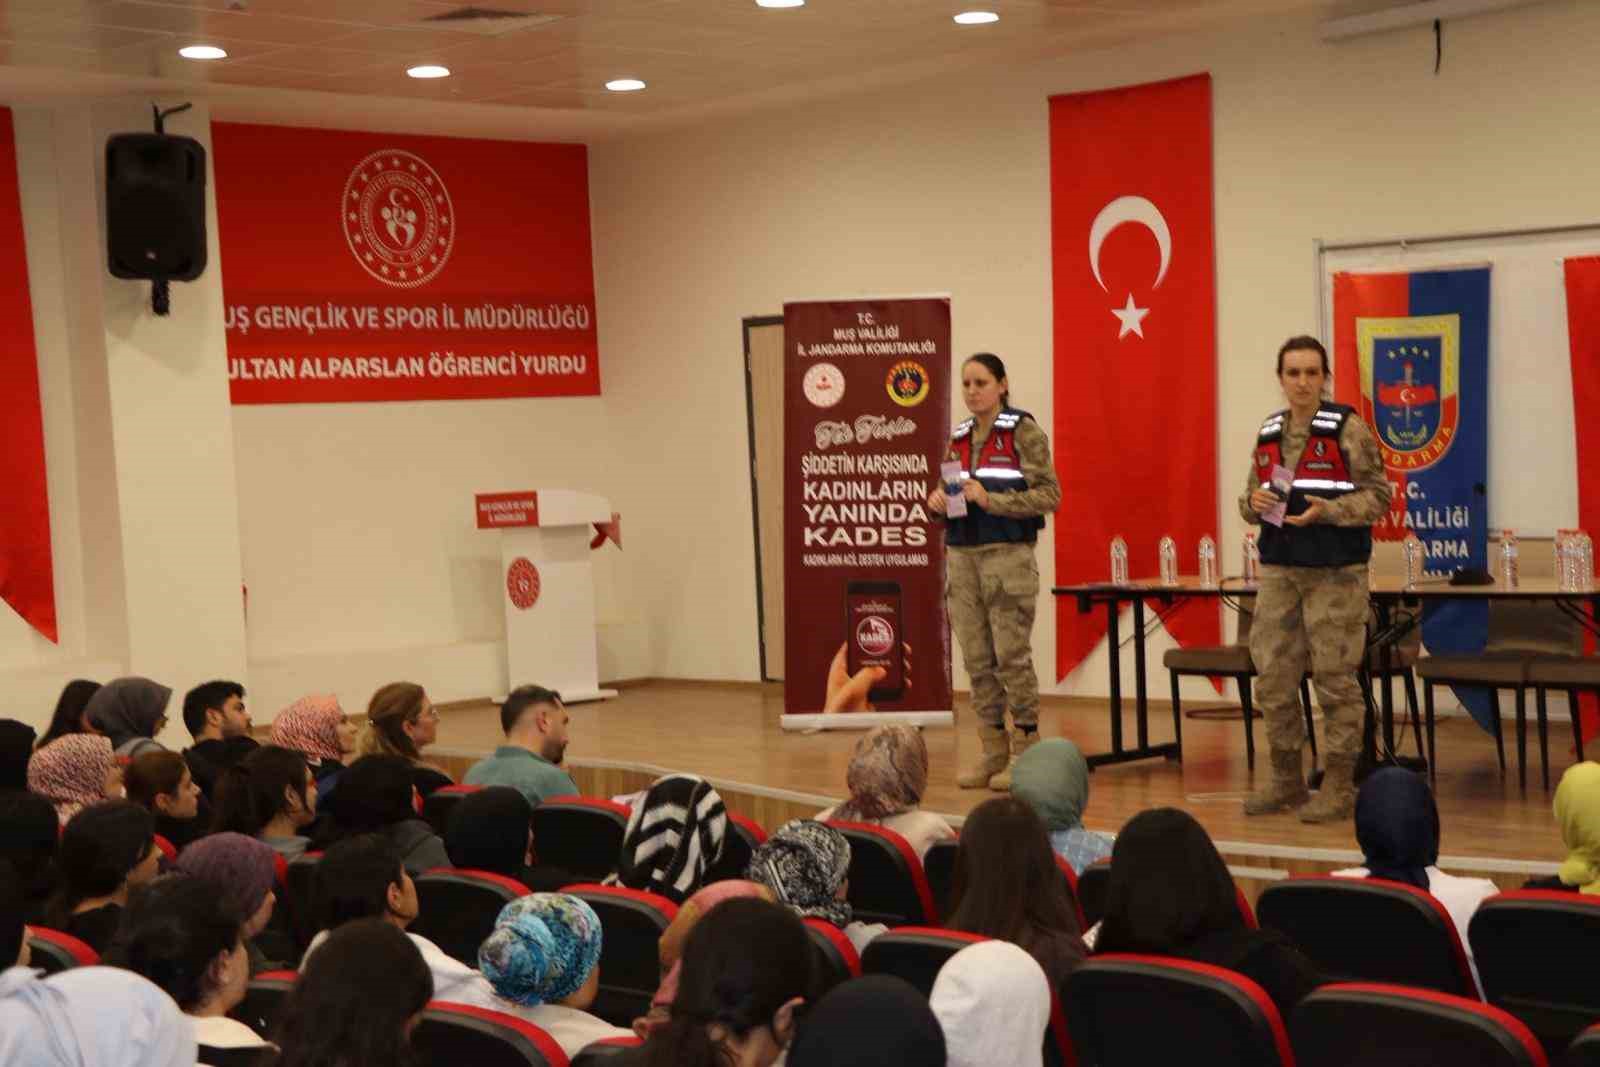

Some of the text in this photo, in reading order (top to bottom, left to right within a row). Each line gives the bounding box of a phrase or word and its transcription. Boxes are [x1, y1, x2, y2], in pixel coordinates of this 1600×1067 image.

[223, 302, 589, 335] UŞ GENÇLİK VE SPOR İL MÜDÜRLÜĞÜ
[808, 342, 864, 357] JANDARMA
[228, 351, 586, 380] ULTAN ALPARSLAN ÖĞRENCİ YURDU
[801, 451, 929, 479] ŞİDDETİN KARŞISINDA
[803, 480, 928, 501] KADINLARIN
[1390, 480, 1426, 499] T.C.
[802, 503, 929, 524] YANINDA
[1390, 505, 1469, 529] VALİLİĞİ
[804, 526, 928, 547] KADES
